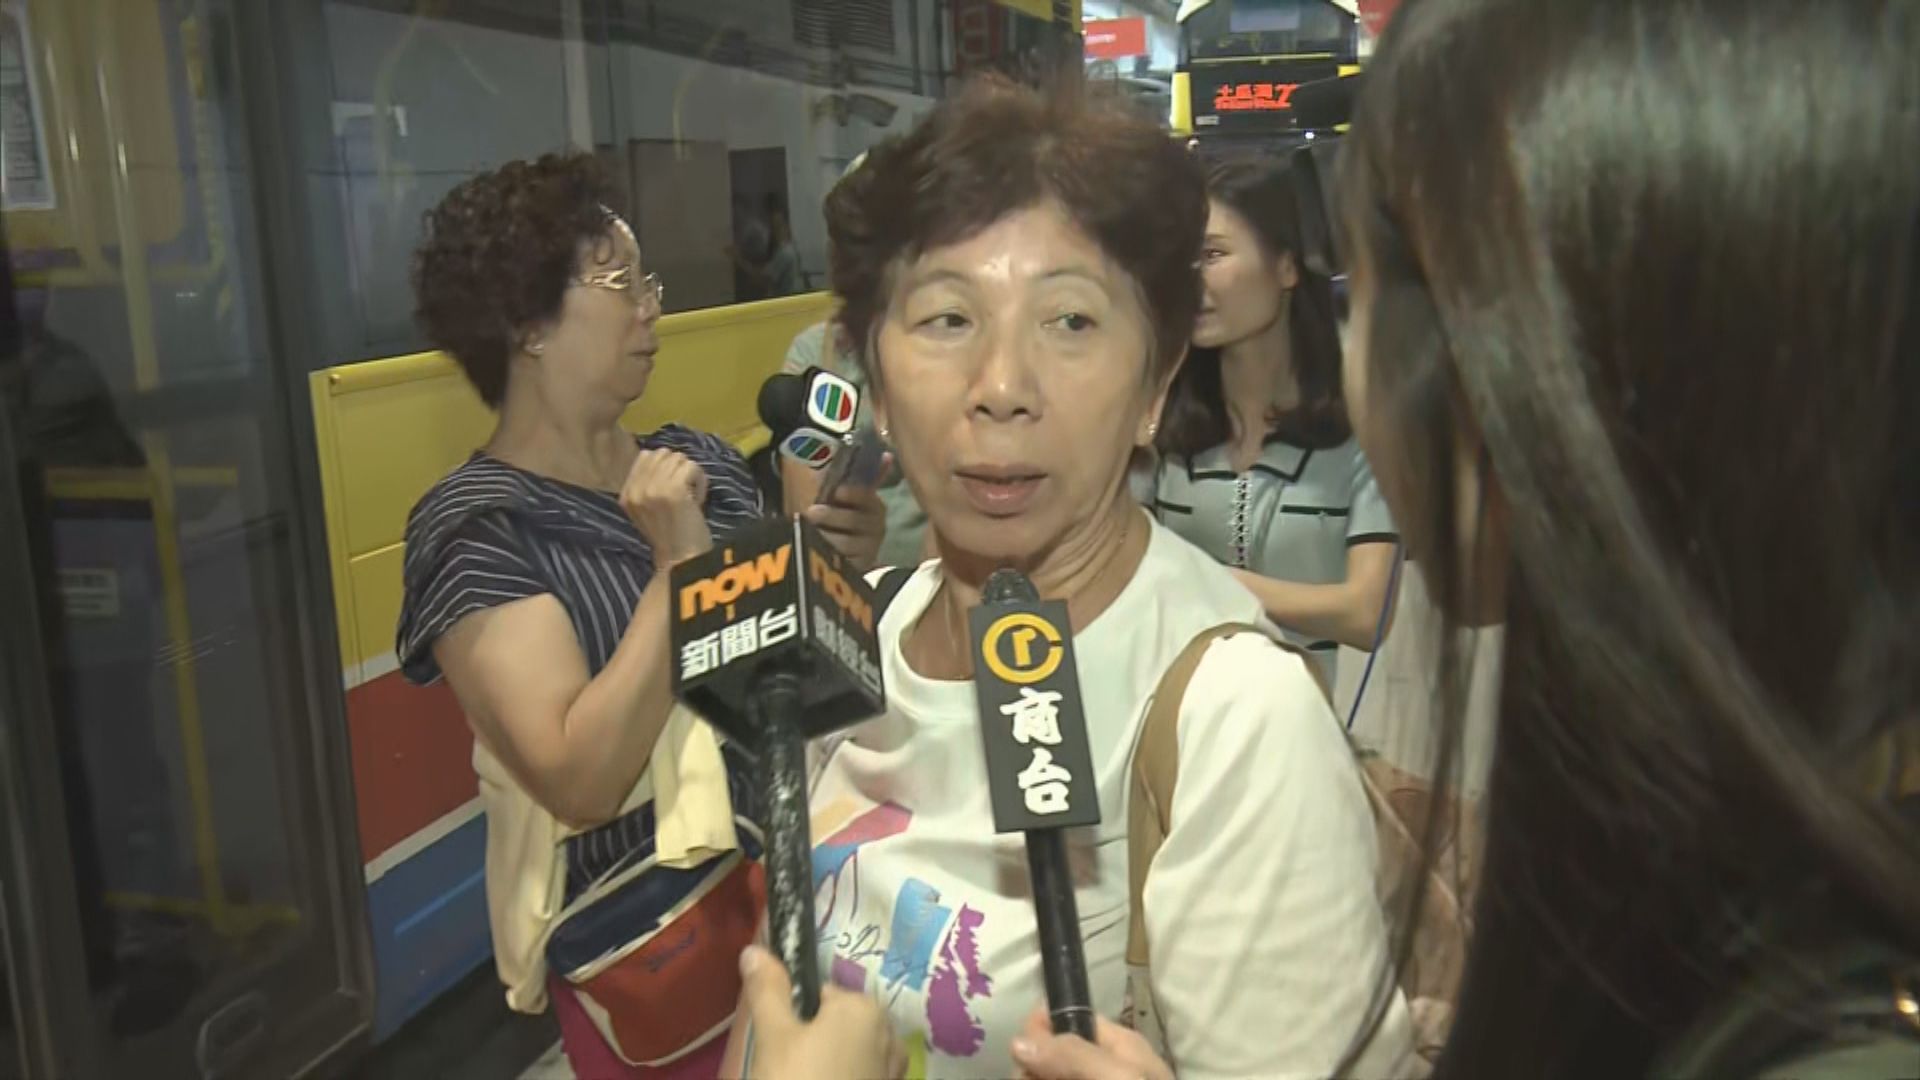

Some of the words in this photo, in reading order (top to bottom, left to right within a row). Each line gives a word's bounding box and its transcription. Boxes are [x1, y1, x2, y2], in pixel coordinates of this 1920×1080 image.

[680, 543, 791, 621] now
[808, 548, 873, 632] now
[681, 603, 798, 681] 新聞台
[999, 686, 1073, 815] 商台
